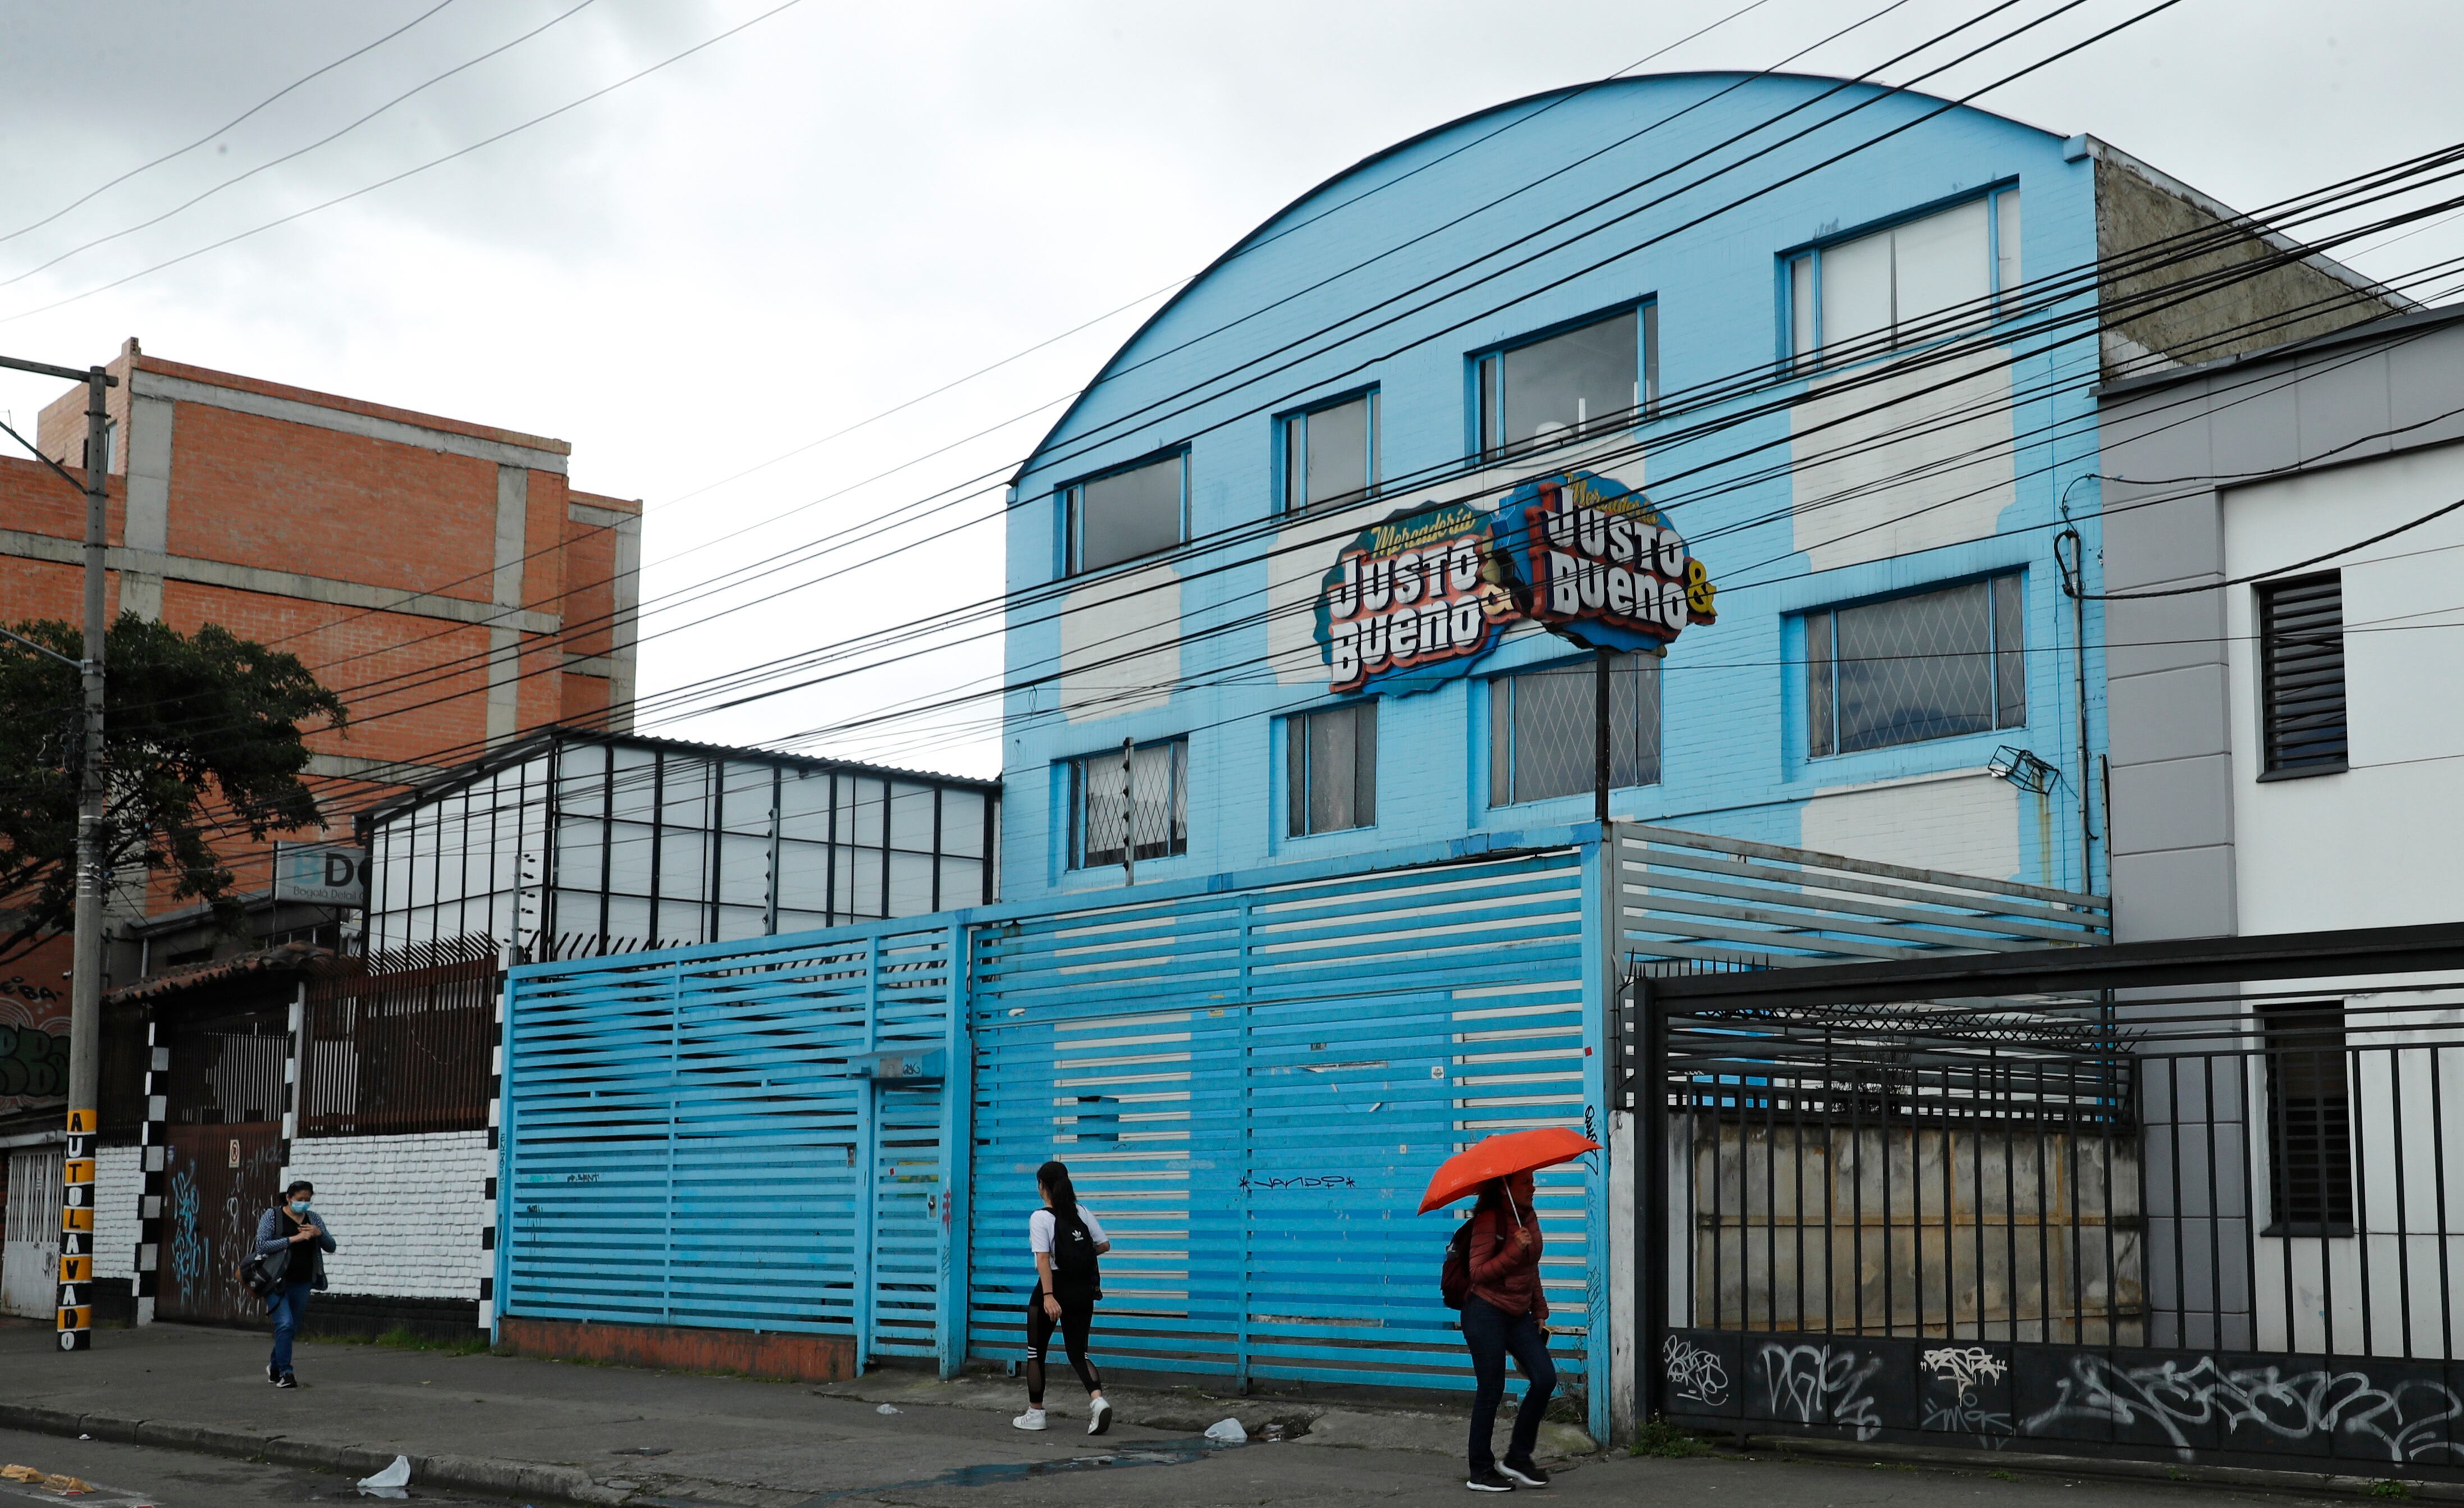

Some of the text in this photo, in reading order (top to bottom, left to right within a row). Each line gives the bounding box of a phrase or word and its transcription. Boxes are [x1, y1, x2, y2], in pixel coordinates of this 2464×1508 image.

[1687, 560, 1718, 616] &
[294, 886, 328, 898] Bogotá
[61, 1112, 84, 1351] AUTOLAVADO
